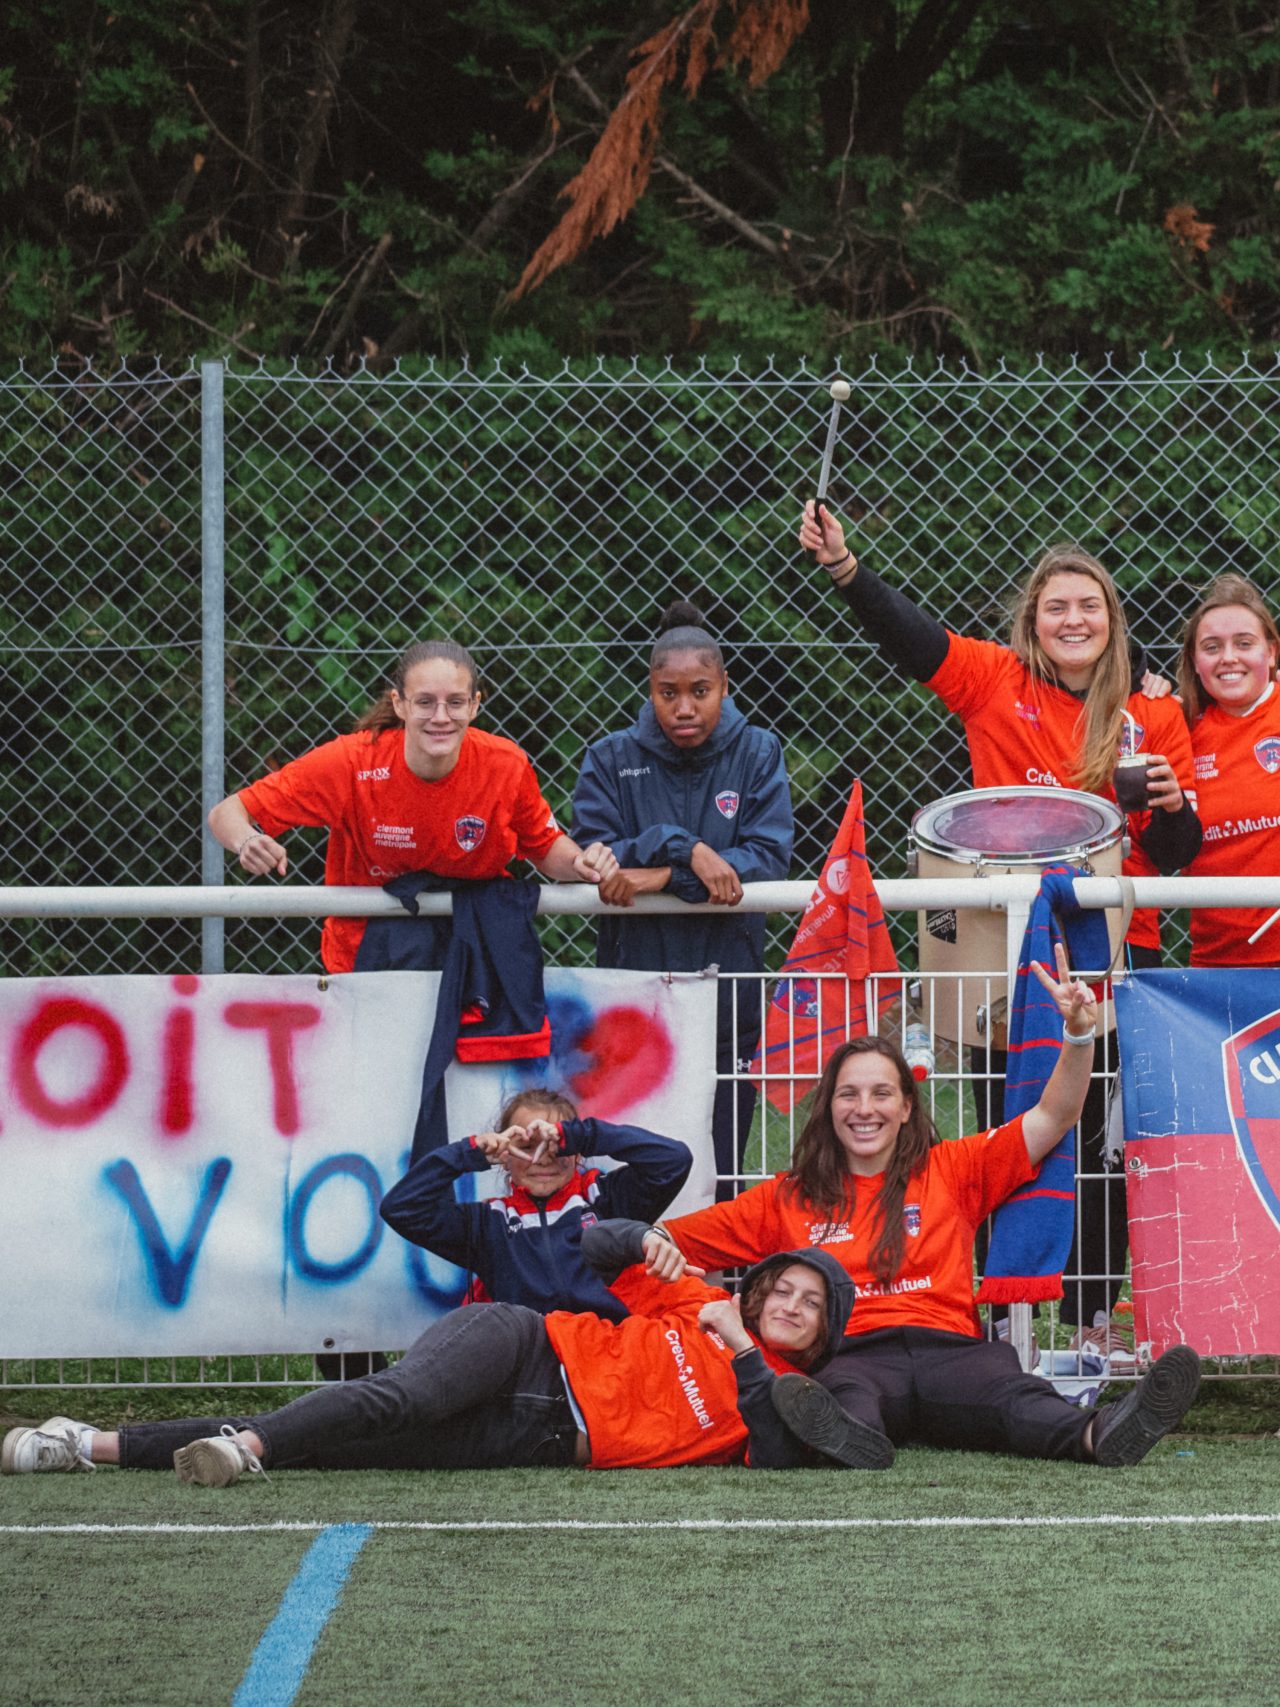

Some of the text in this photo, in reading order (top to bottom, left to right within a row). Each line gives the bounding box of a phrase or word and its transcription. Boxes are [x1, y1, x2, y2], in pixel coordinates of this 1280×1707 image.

[376, 824, 414, 835] clermont
[373, 832, 411, 842] auvergne
[682, 1379, 714, 1429] Mutuel
